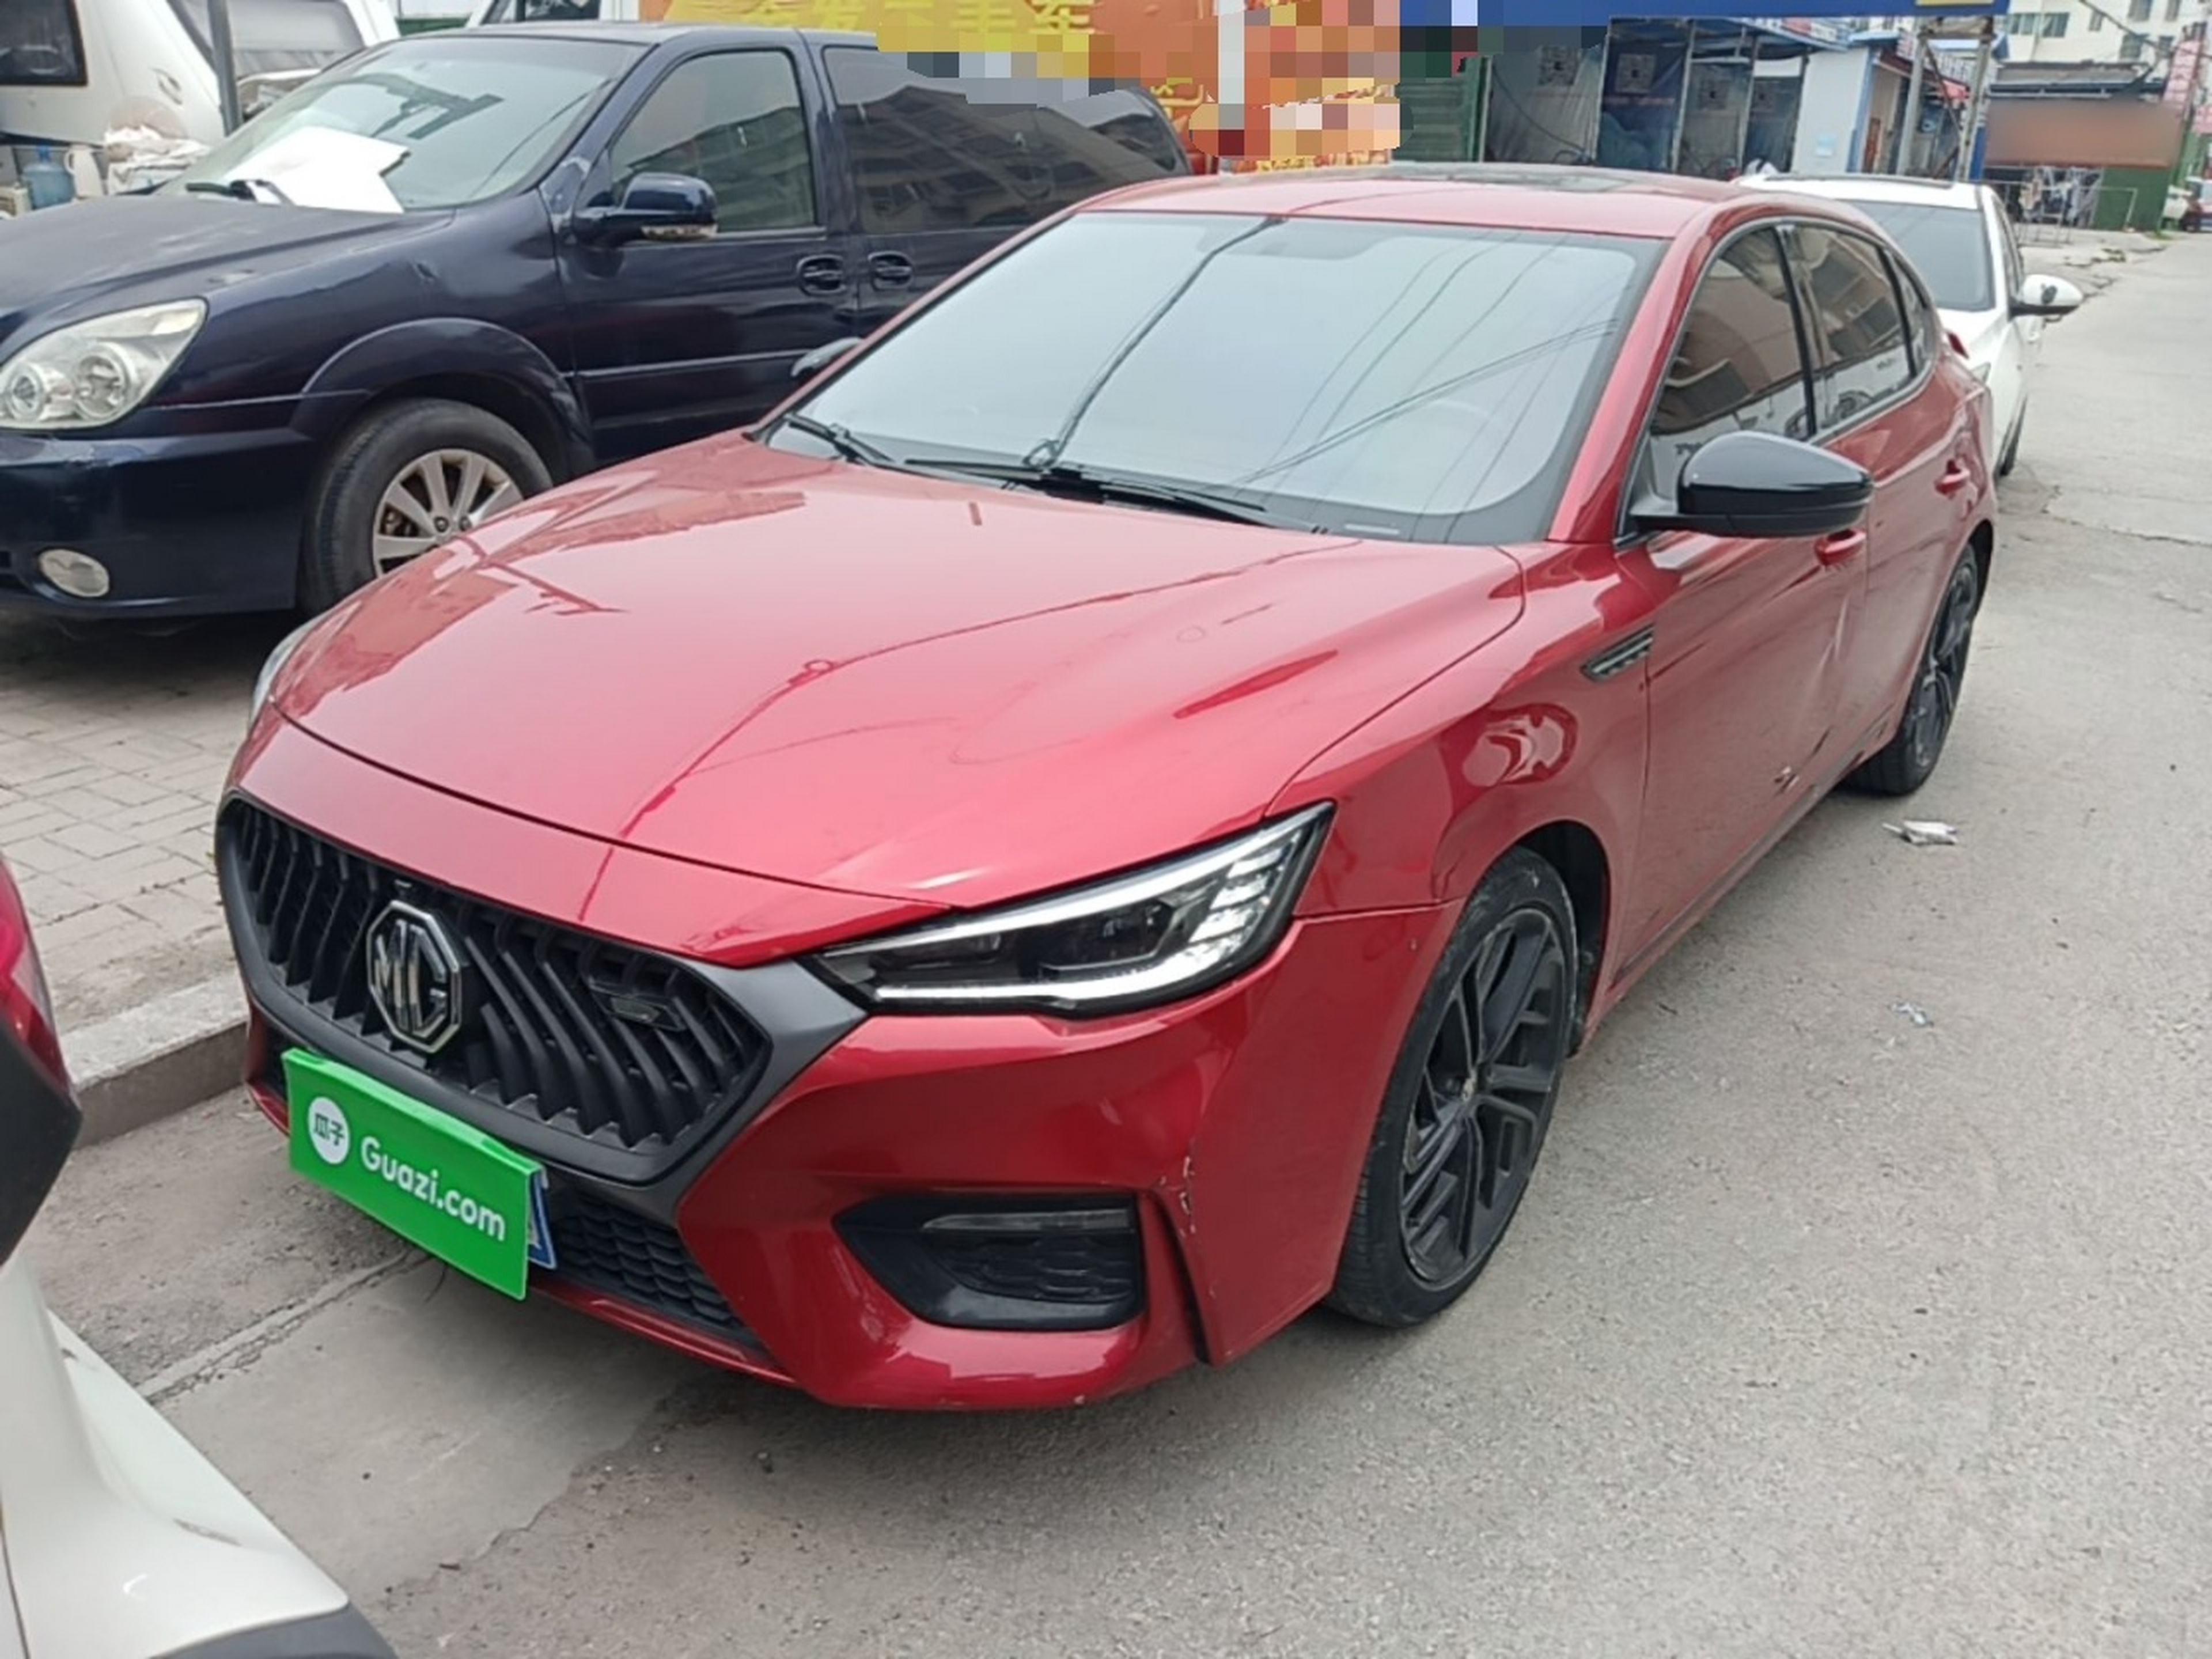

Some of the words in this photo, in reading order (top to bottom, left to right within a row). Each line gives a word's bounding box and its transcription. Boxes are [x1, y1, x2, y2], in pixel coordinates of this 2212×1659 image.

[374, 919, 447, 1037] MG
[314, 1112, 345, 1146] 瓜子
[361, 1135, 506, 1241] Guazi.com
